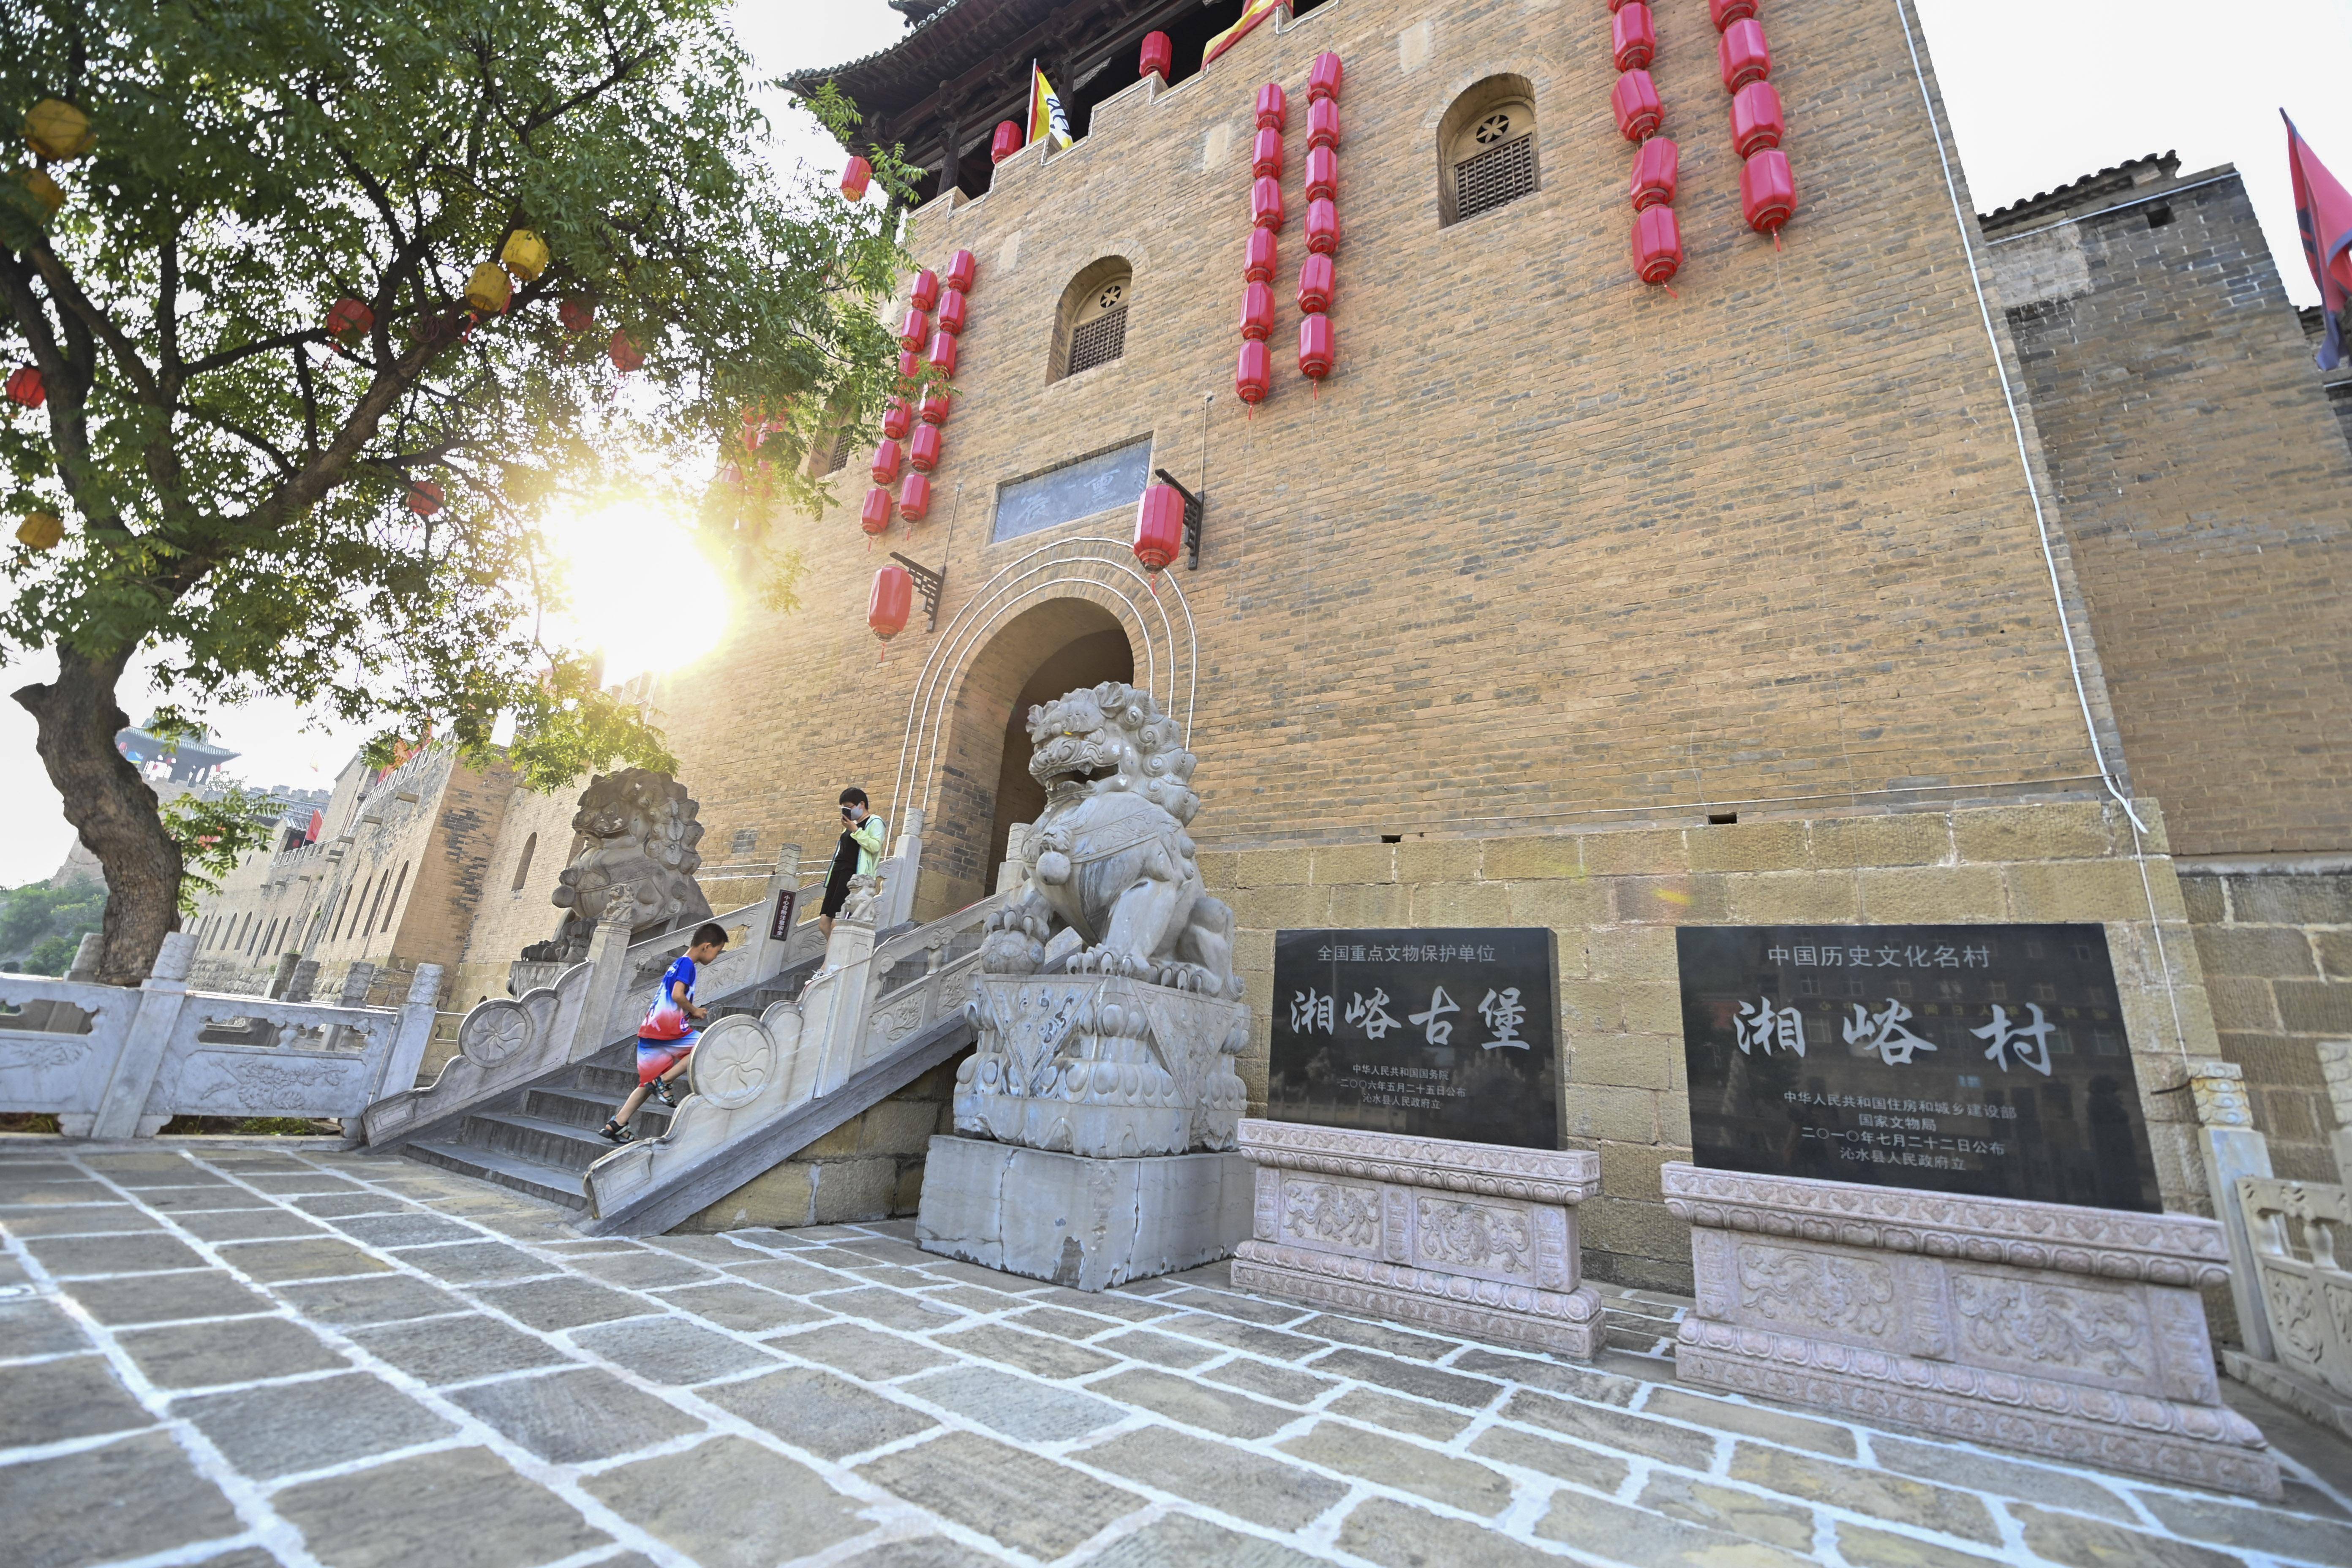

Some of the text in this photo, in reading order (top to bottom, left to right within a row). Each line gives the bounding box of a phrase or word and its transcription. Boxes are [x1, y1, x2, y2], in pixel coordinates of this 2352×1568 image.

[1318, 945, 1496, 963] 全国重点文物保护单位
[1768, 946, 1990, 969] 中国历史文化名村
[1290, 985, 1530, 1051] 湘峪古堡
[1733, 996, 2056, 1076] 湘峪村
[1353, 1064, 1449, 1081] 中华人民共和国国务院
[1362, 1093, 1441, 1110] 沁水县人民政府立
[1783, 1091, 2017, 1120] 中华人民共和国住房和城乡建设部
[1859, 1114, 1937, 1132] 国家文物局
[1840, 1147, 1967, 1171] 沁水县人民政府立
